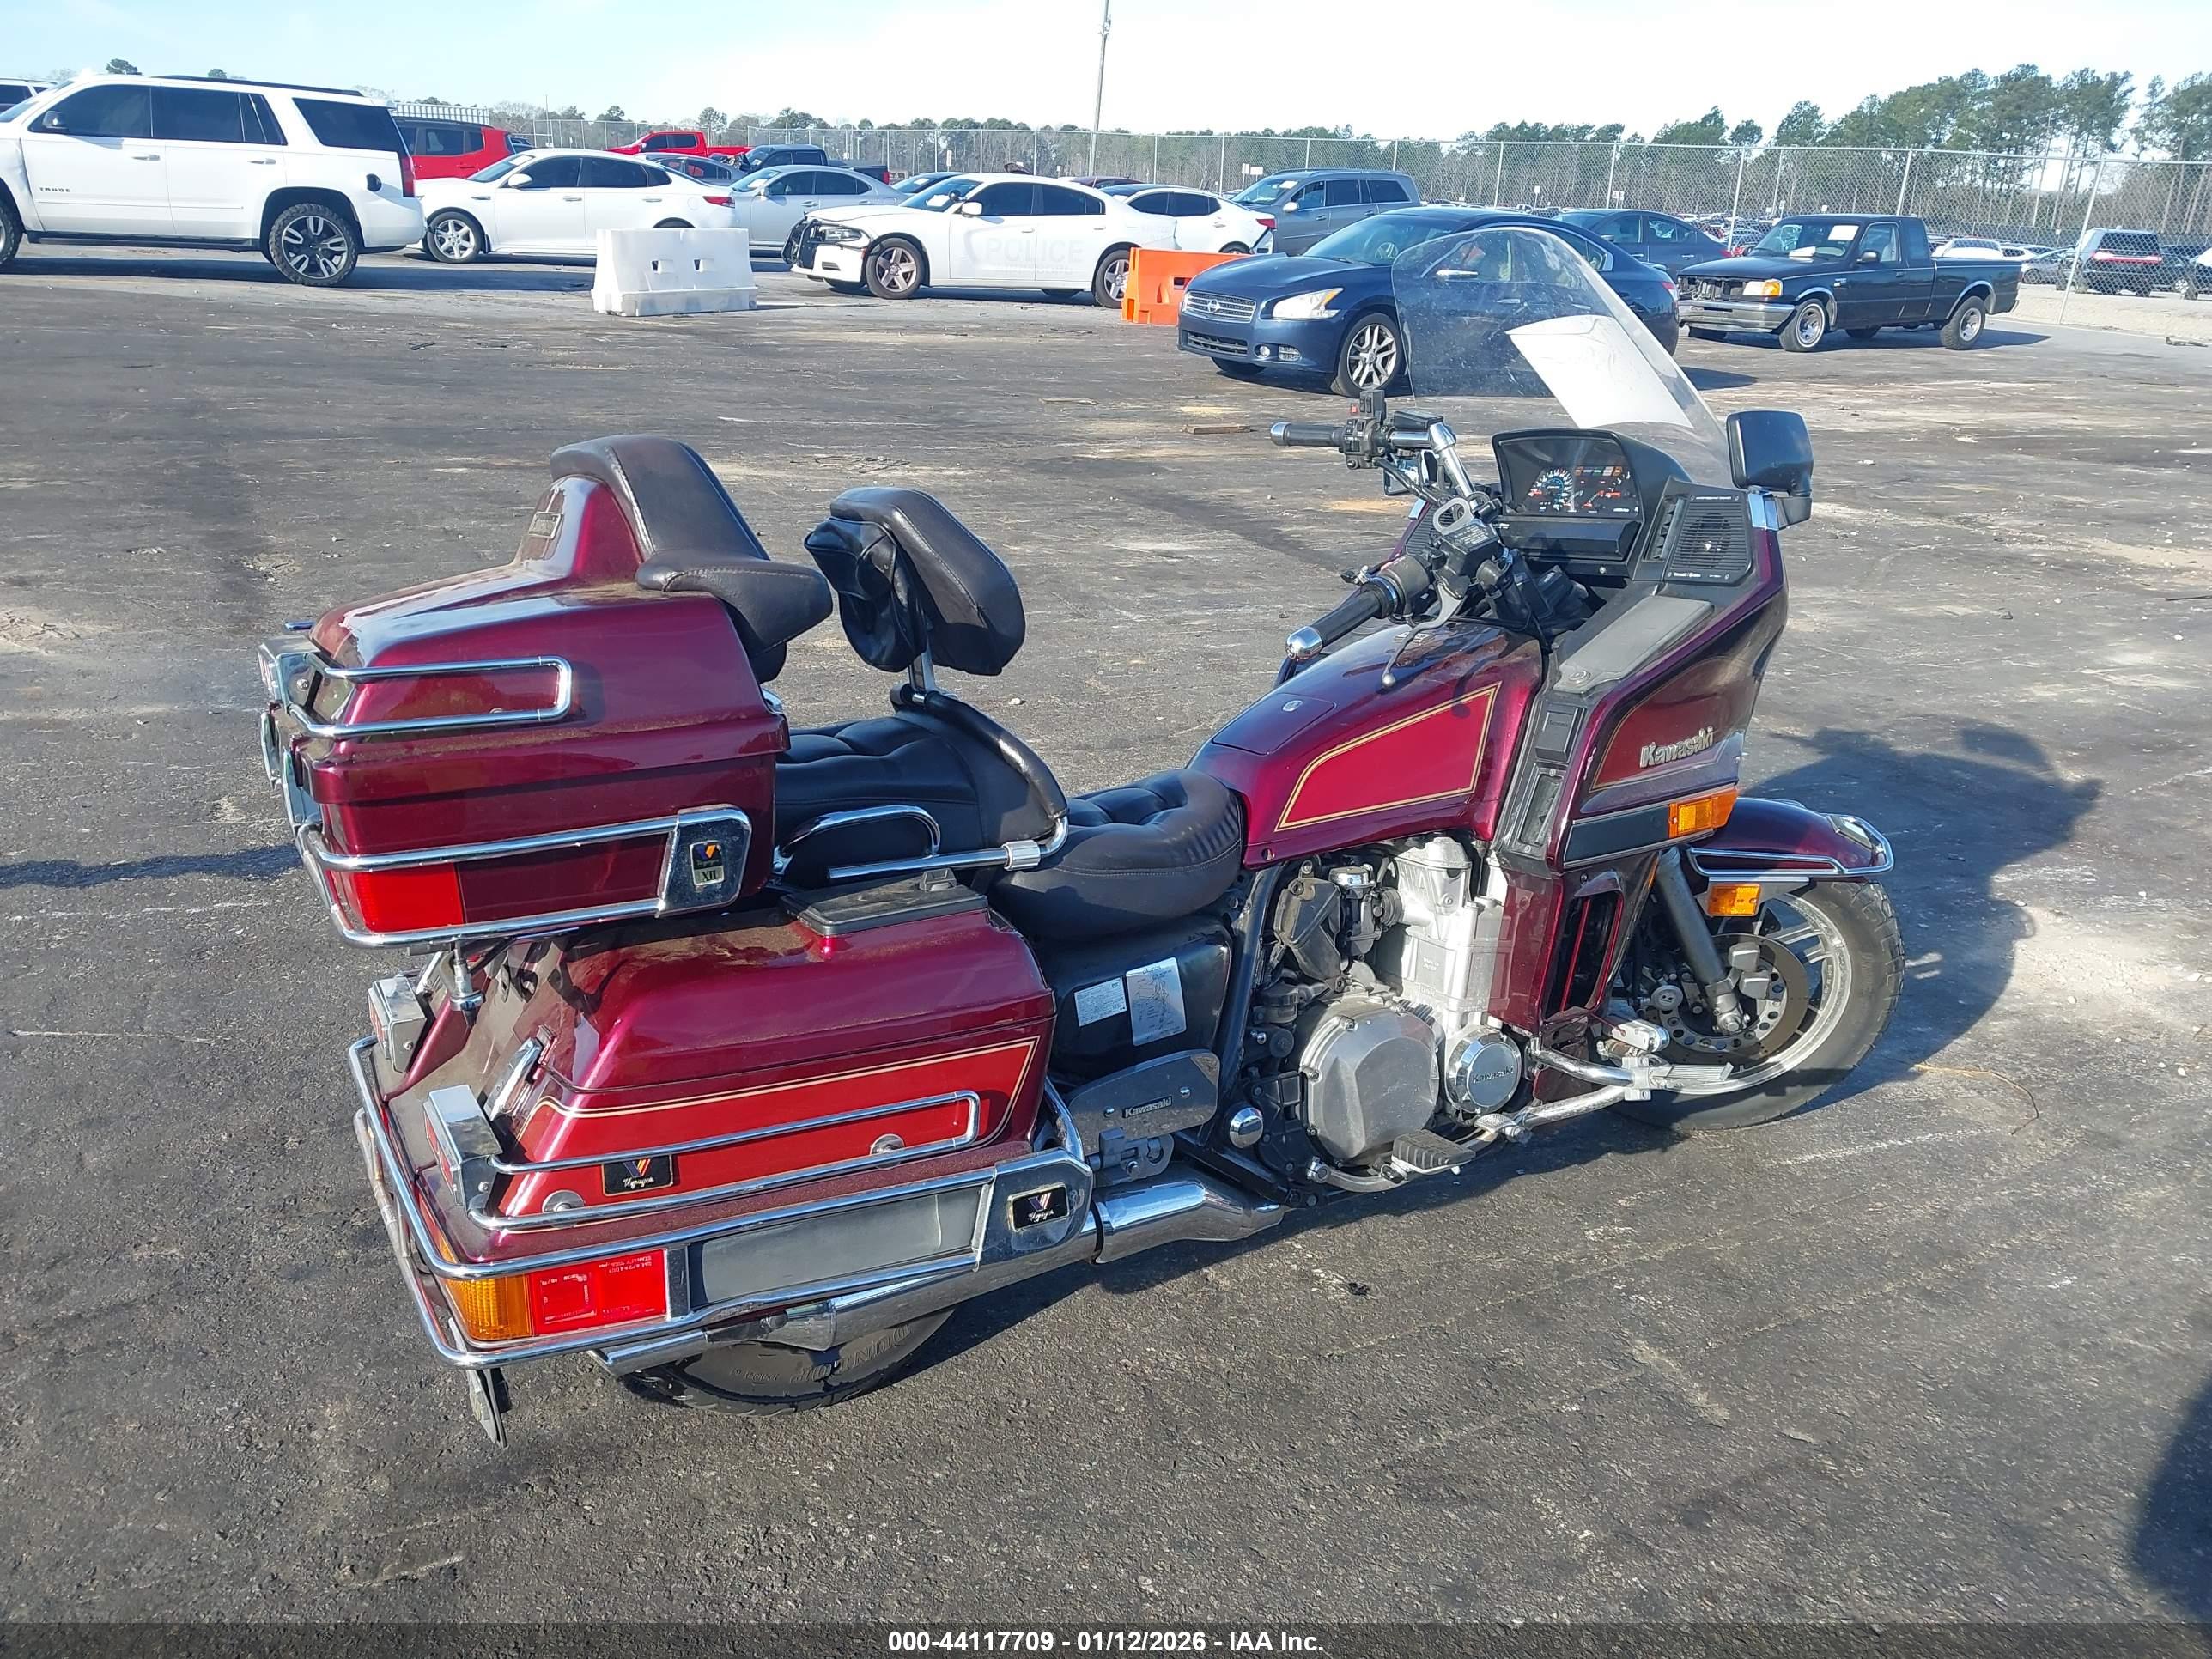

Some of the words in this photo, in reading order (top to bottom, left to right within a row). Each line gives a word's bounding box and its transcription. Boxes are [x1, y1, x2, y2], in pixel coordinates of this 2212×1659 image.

[985, 238, 1086, 263] POLICE
[1639, 726, 1714, 769] Kawasaki
[1472, 1064, 1514, 1084] Kawasaki
[1124, 1097, 1172, 1118] Kawasaki
